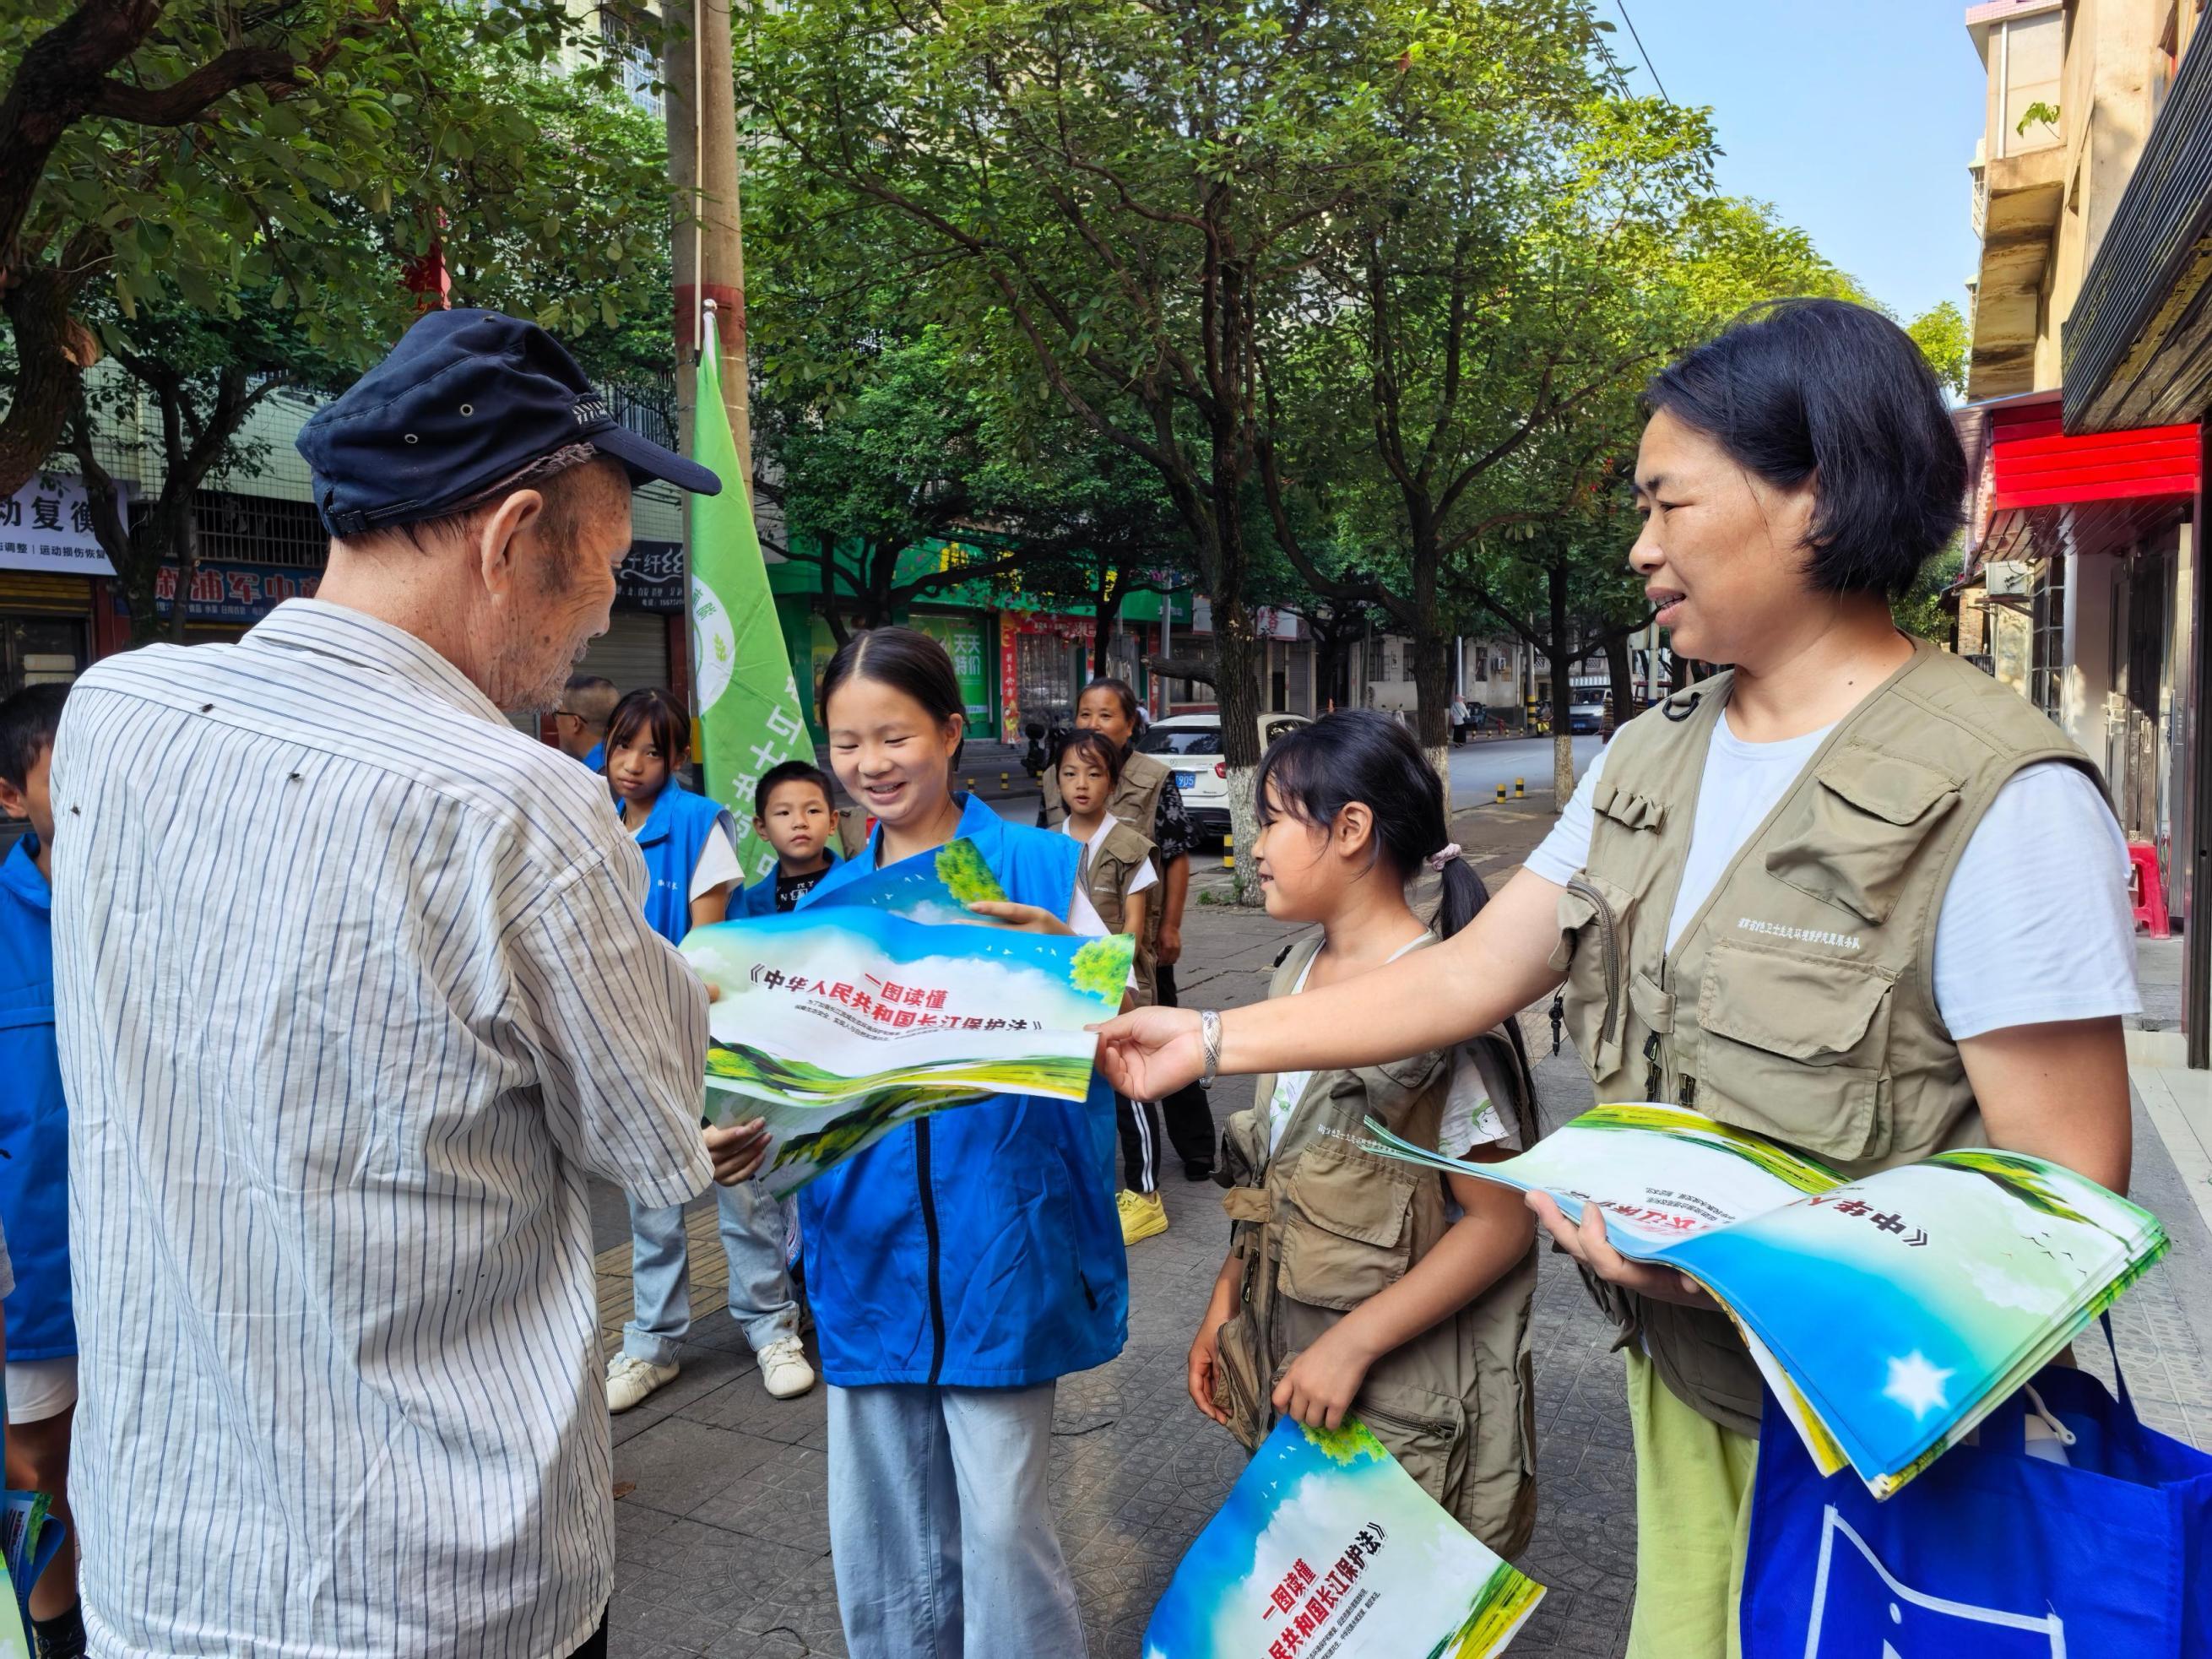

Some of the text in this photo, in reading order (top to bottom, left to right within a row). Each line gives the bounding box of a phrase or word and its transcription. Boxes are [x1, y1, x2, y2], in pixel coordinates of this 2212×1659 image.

[954, 655, 980, 675] 特价
[955, 634, 980, 653] 天天
[865, 973, 949, 1009] 一图读懂
[1788, 1195, 1929, 1247] 《中华人
[1260, 1521, 1385, 1659] 民共和国长江保护法》
[1262, 1558, 1316, 1619] 一图读懂
